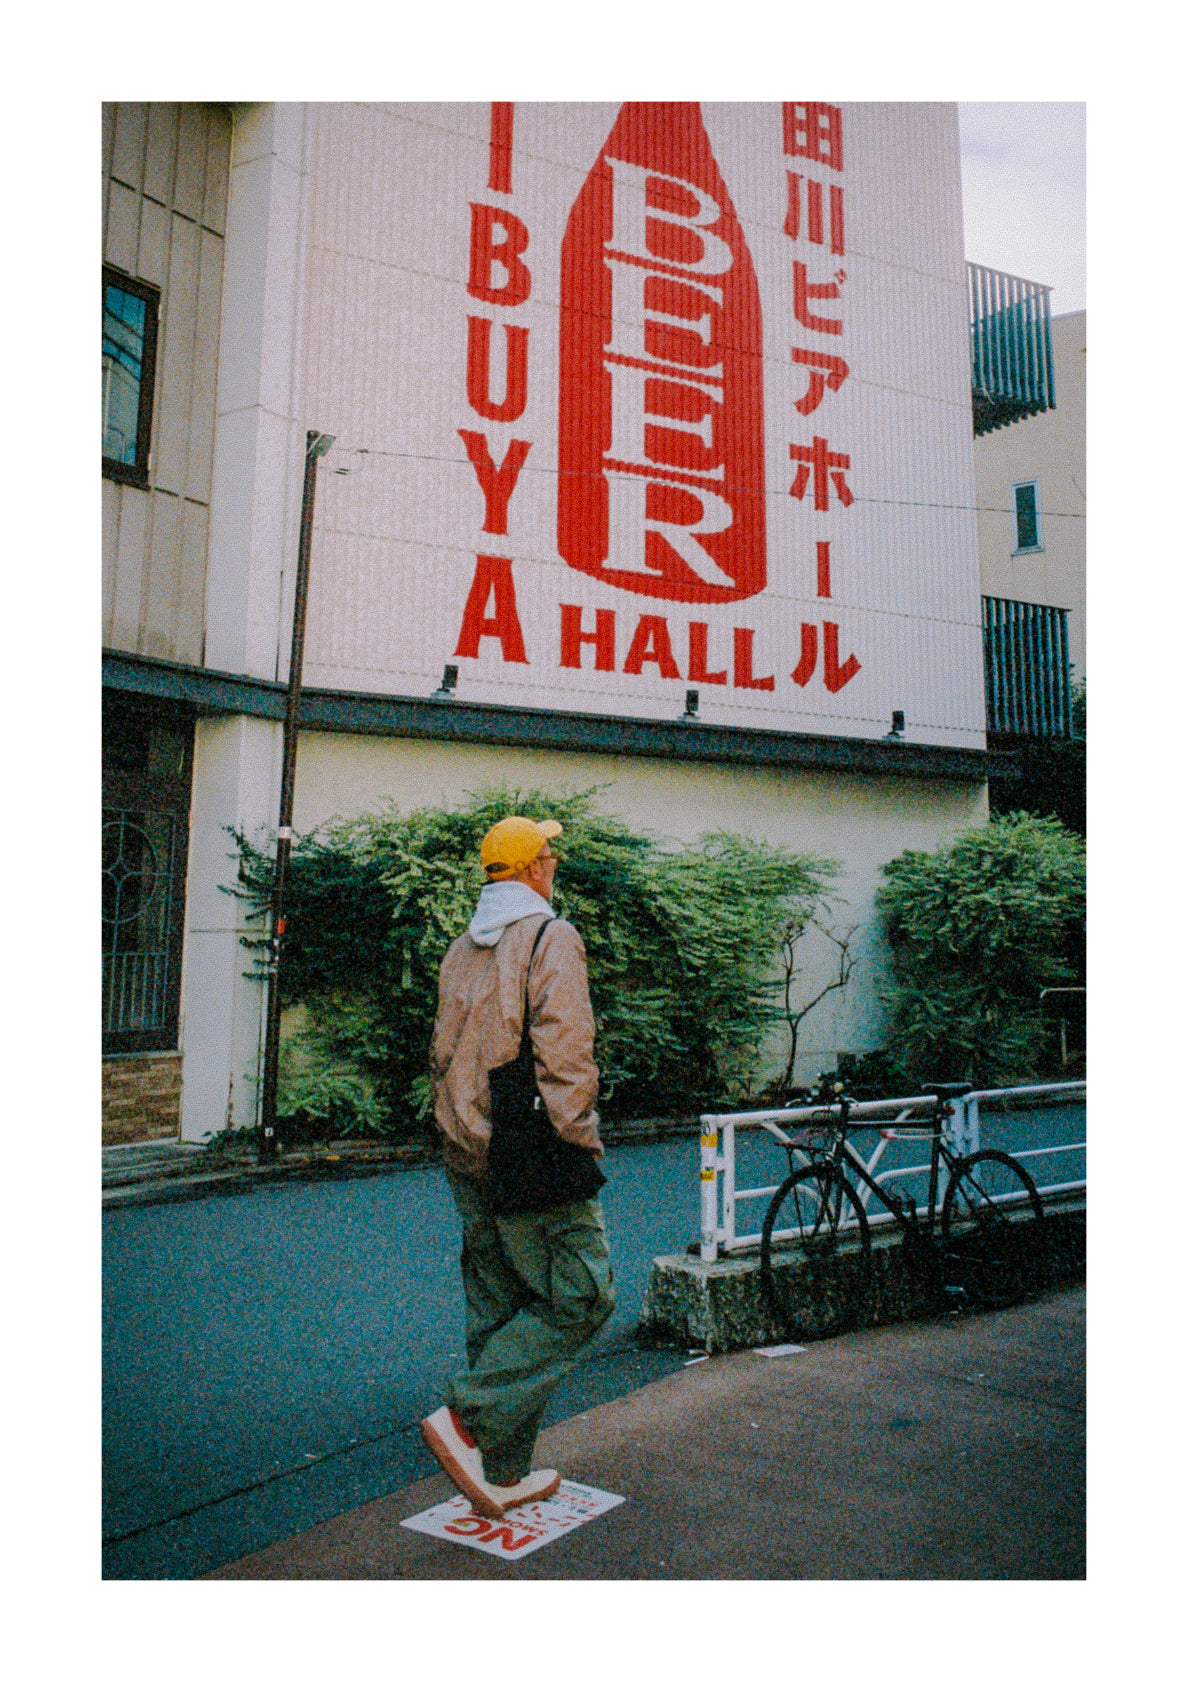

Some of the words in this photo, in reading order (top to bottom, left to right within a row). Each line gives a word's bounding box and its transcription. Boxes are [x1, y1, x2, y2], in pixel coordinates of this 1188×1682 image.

[602, 155, 735, 587] BEER
[783, 102, 861, 692] 田川ビアホール
[559, 603, 775, 692] HALL
